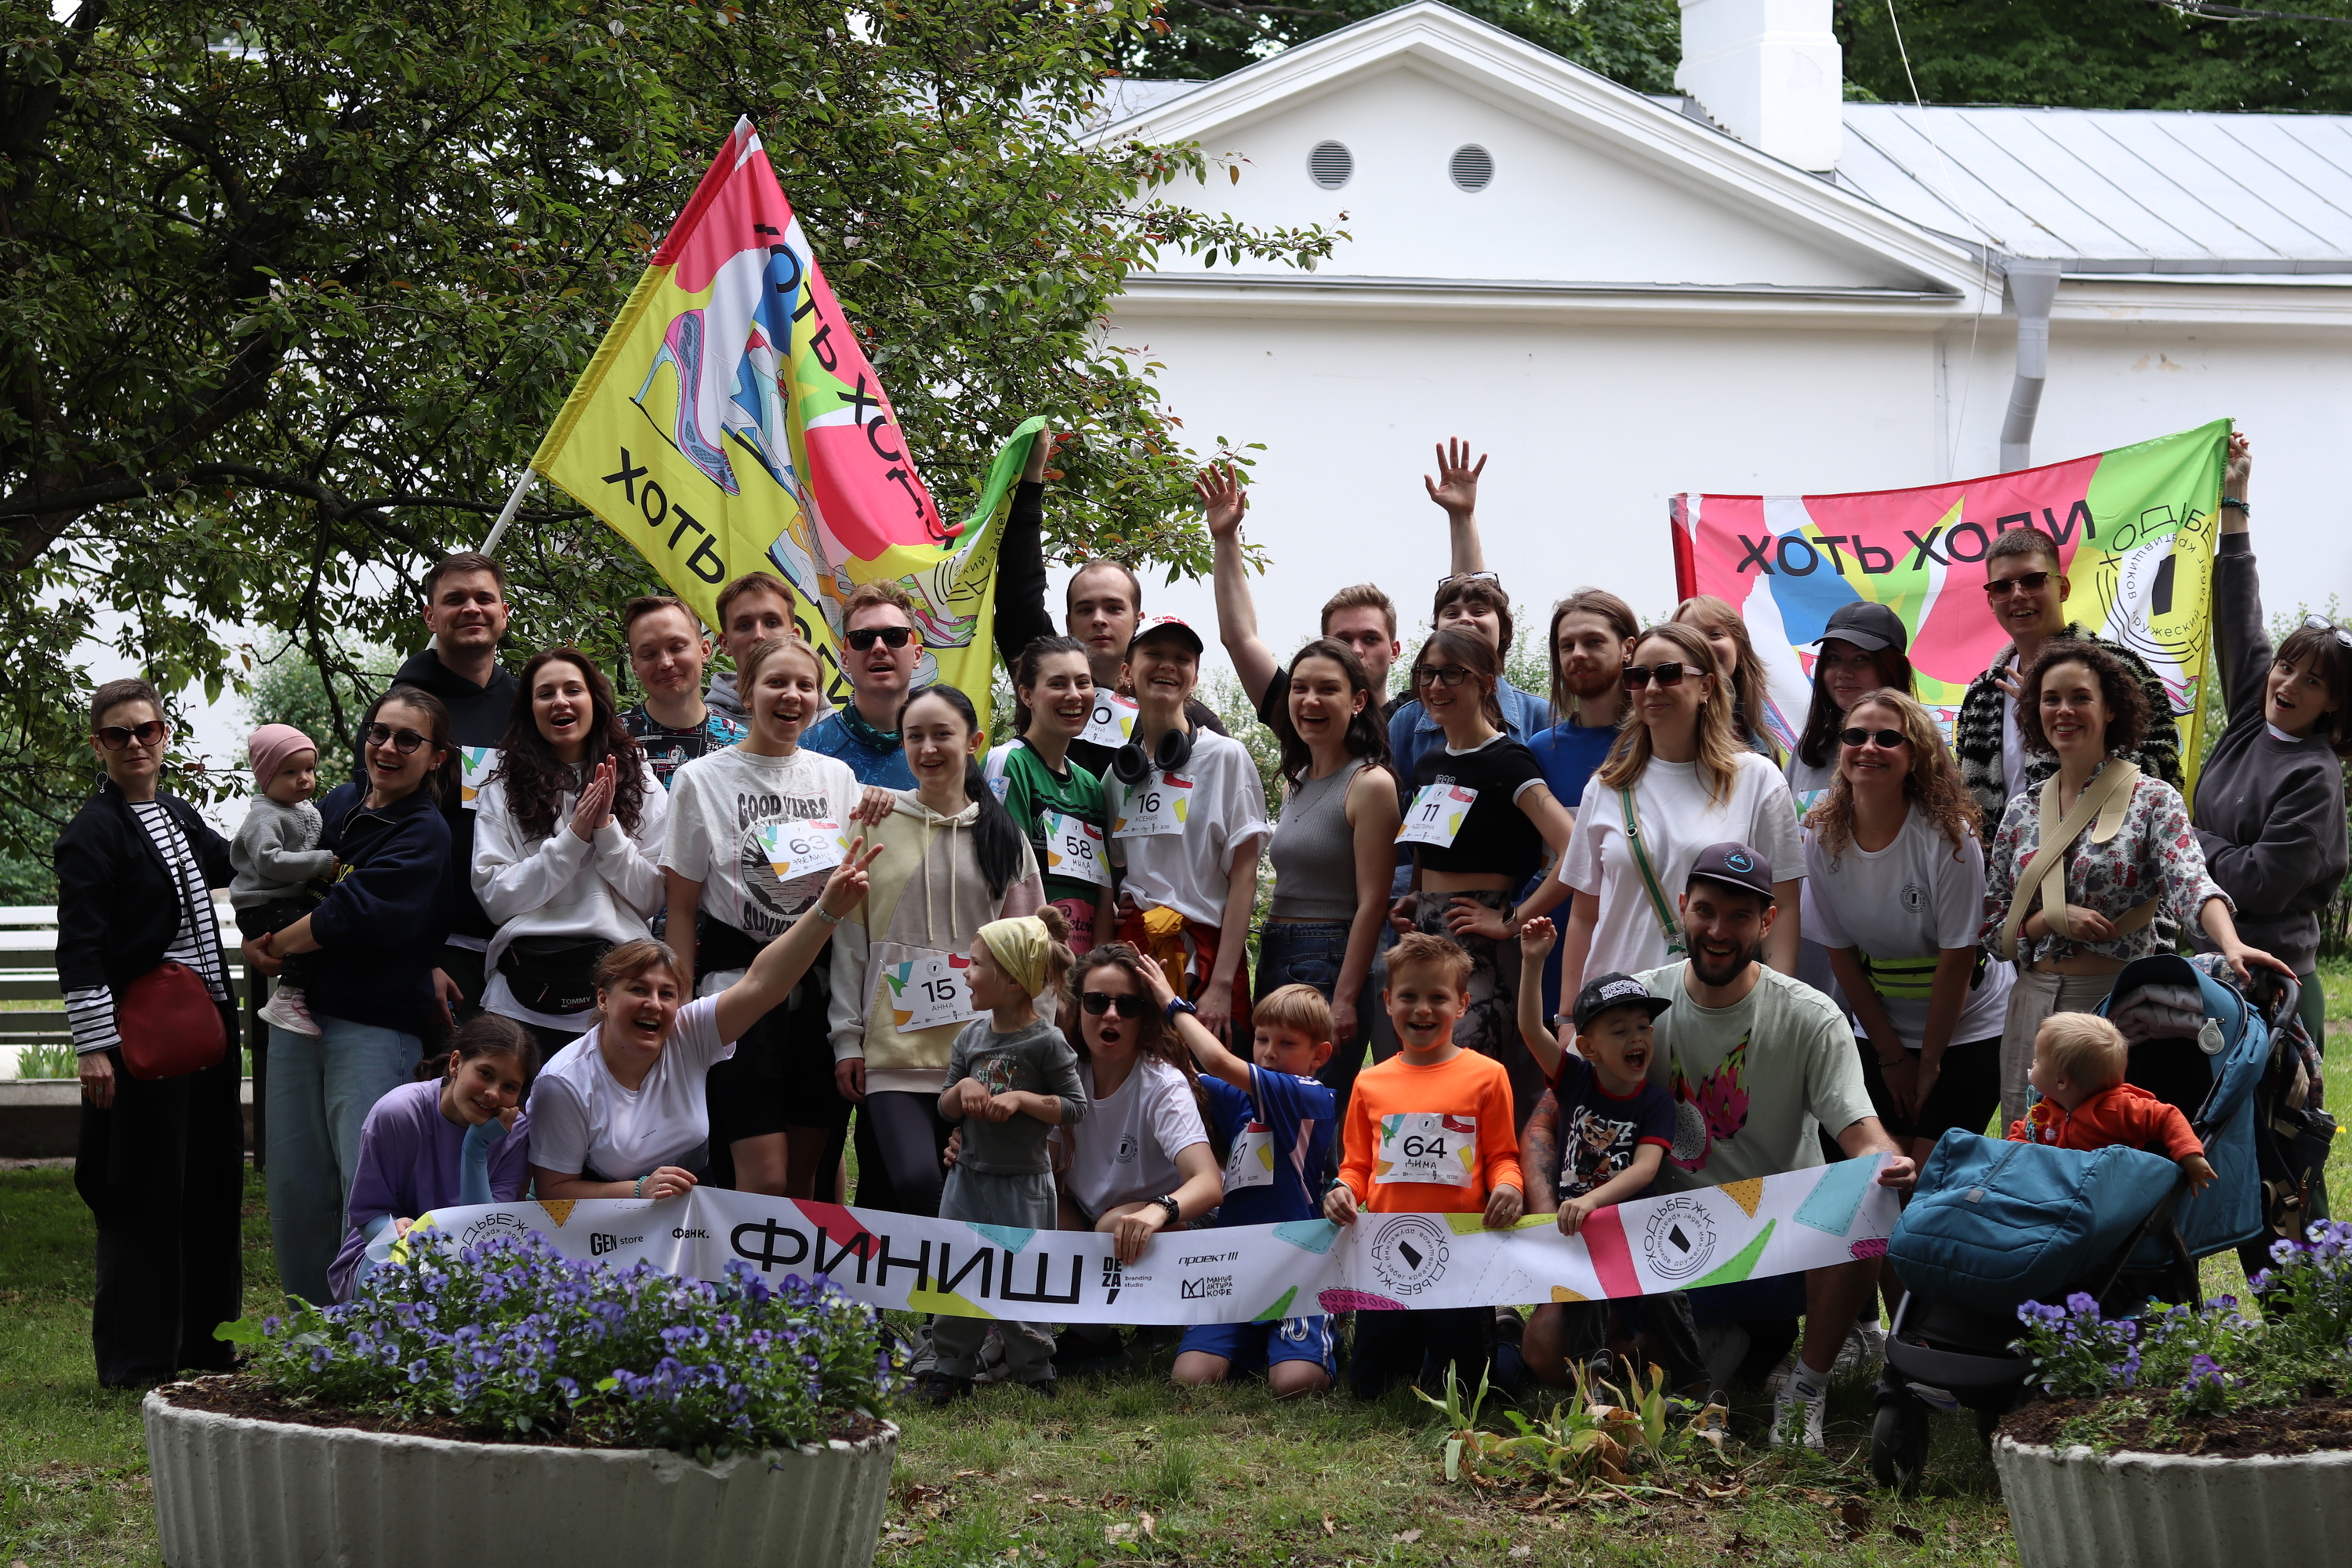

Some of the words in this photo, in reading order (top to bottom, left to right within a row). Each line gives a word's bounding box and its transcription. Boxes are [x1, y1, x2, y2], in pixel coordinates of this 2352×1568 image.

[754, 224, 838, 372] ОТЬ
[601, 445, 725, 585] ХОТЬ
[1737, 533, 1894, 577] ХОТЬ
[1092, 706, 1112, 724] 0
[1087, 721, 1106, 733] ТРИЙ
[737, 793, 782, 832] GOOD
[783, 796, 828, 819] VIBES
[1138, 792, 1161, 814] 16
[1421, 803, 1441, 822] 11
[789, 835, 830, 855] 63
[1066, 836, 1093, 860] 58
[921, 978, 956, 1003] 15
[931, 1002, 954, 1011] АННА
[1231, 1142, 1248, 1171] 57
[1403, 1135, 1447, 1159] 64
[1405, 1159, 1437, 1170] ДИМА
[1644, 1197, 1717, 1262] ХОДЬБЕЖКА
[1683, 1213, 1703, 1229] забег
[672, 1227, 710, 1240] Фанк.
[590, 1232, 618, 1257] GEN
[619, 1236, 644, 1245] store
[730, 1218, 1083, 1305] ФИНИШ
[1103, 1257, 1122, 1272] DE
[1371, 1236, 1450, 1295] ХОДЬБЕЖКА
[1386, 1263, 1406, 1280] забег
[1207, 1275, 1233, 1284] МАНУФ
[1207, 1282, 1233, 1290] АКТУРА
[1207, 1289, 1232, 1298] КОФЕ
